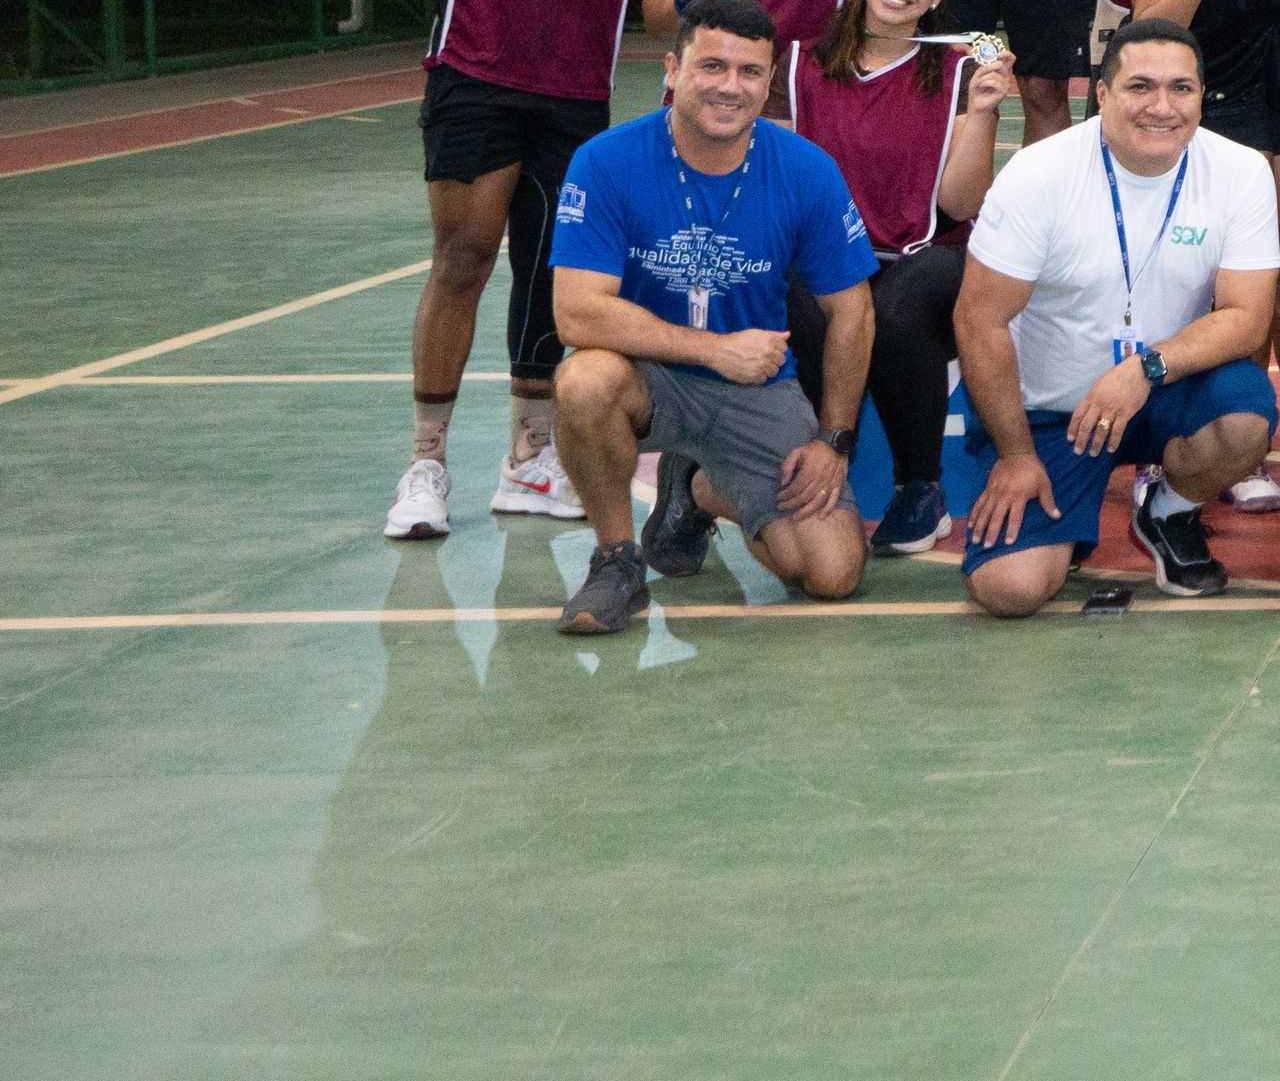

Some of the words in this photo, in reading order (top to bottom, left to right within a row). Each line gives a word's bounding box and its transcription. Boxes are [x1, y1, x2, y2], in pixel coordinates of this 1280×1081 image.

[1171, 225, 1208, 246] SQV
[710, 254, 732, 270] de
[736, 258, 772, 274] vida
